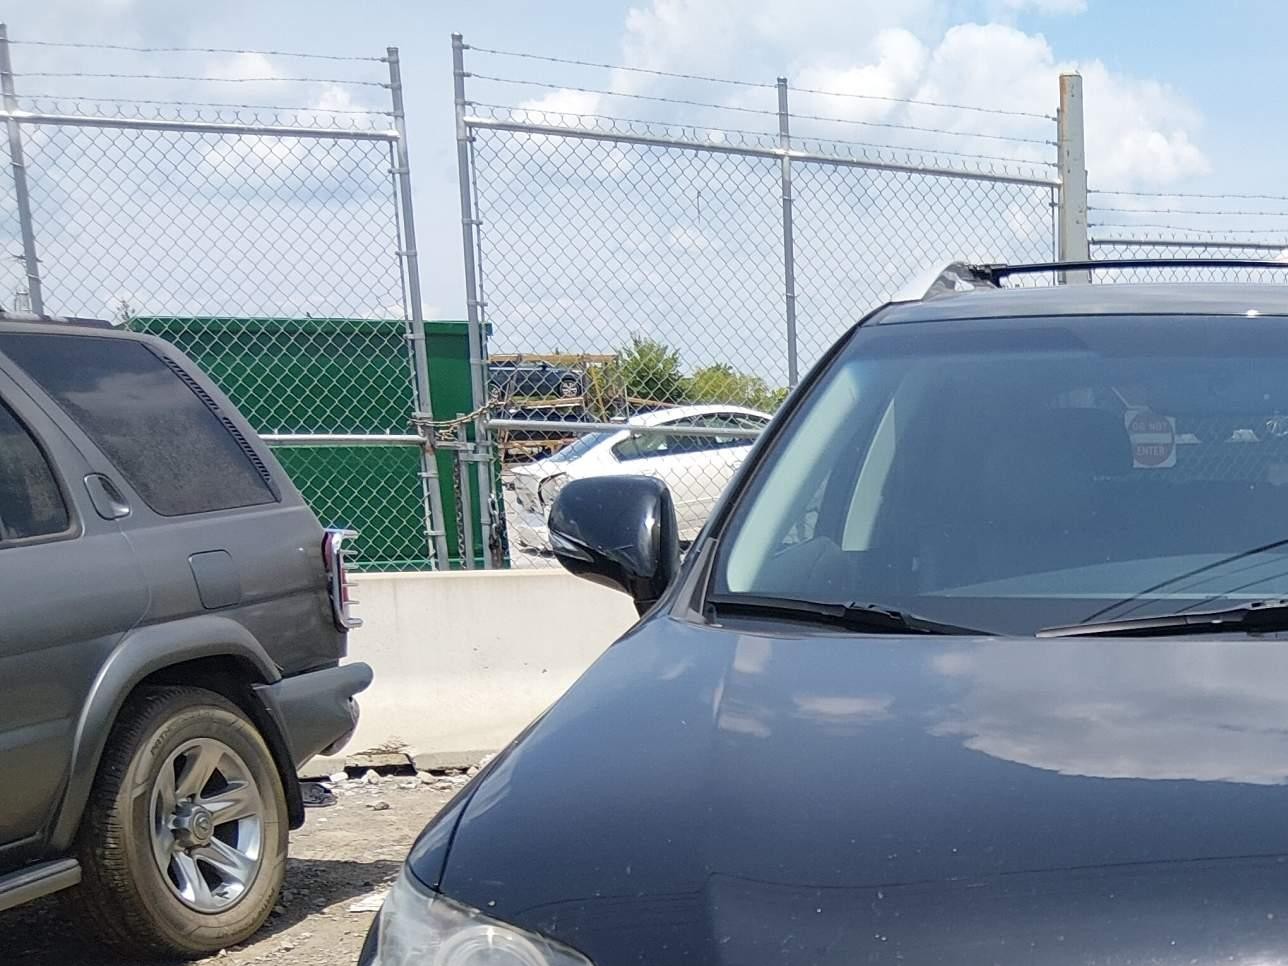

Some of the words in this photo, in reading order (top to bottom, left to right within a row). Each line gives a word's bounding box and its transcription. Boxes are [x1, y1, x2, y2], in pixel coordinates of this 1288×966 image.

[1132, 421, 1145, 432] DO
[1148, 421, 1168, 432] NOT
[1136, 445, 1166, 456] ENTER
